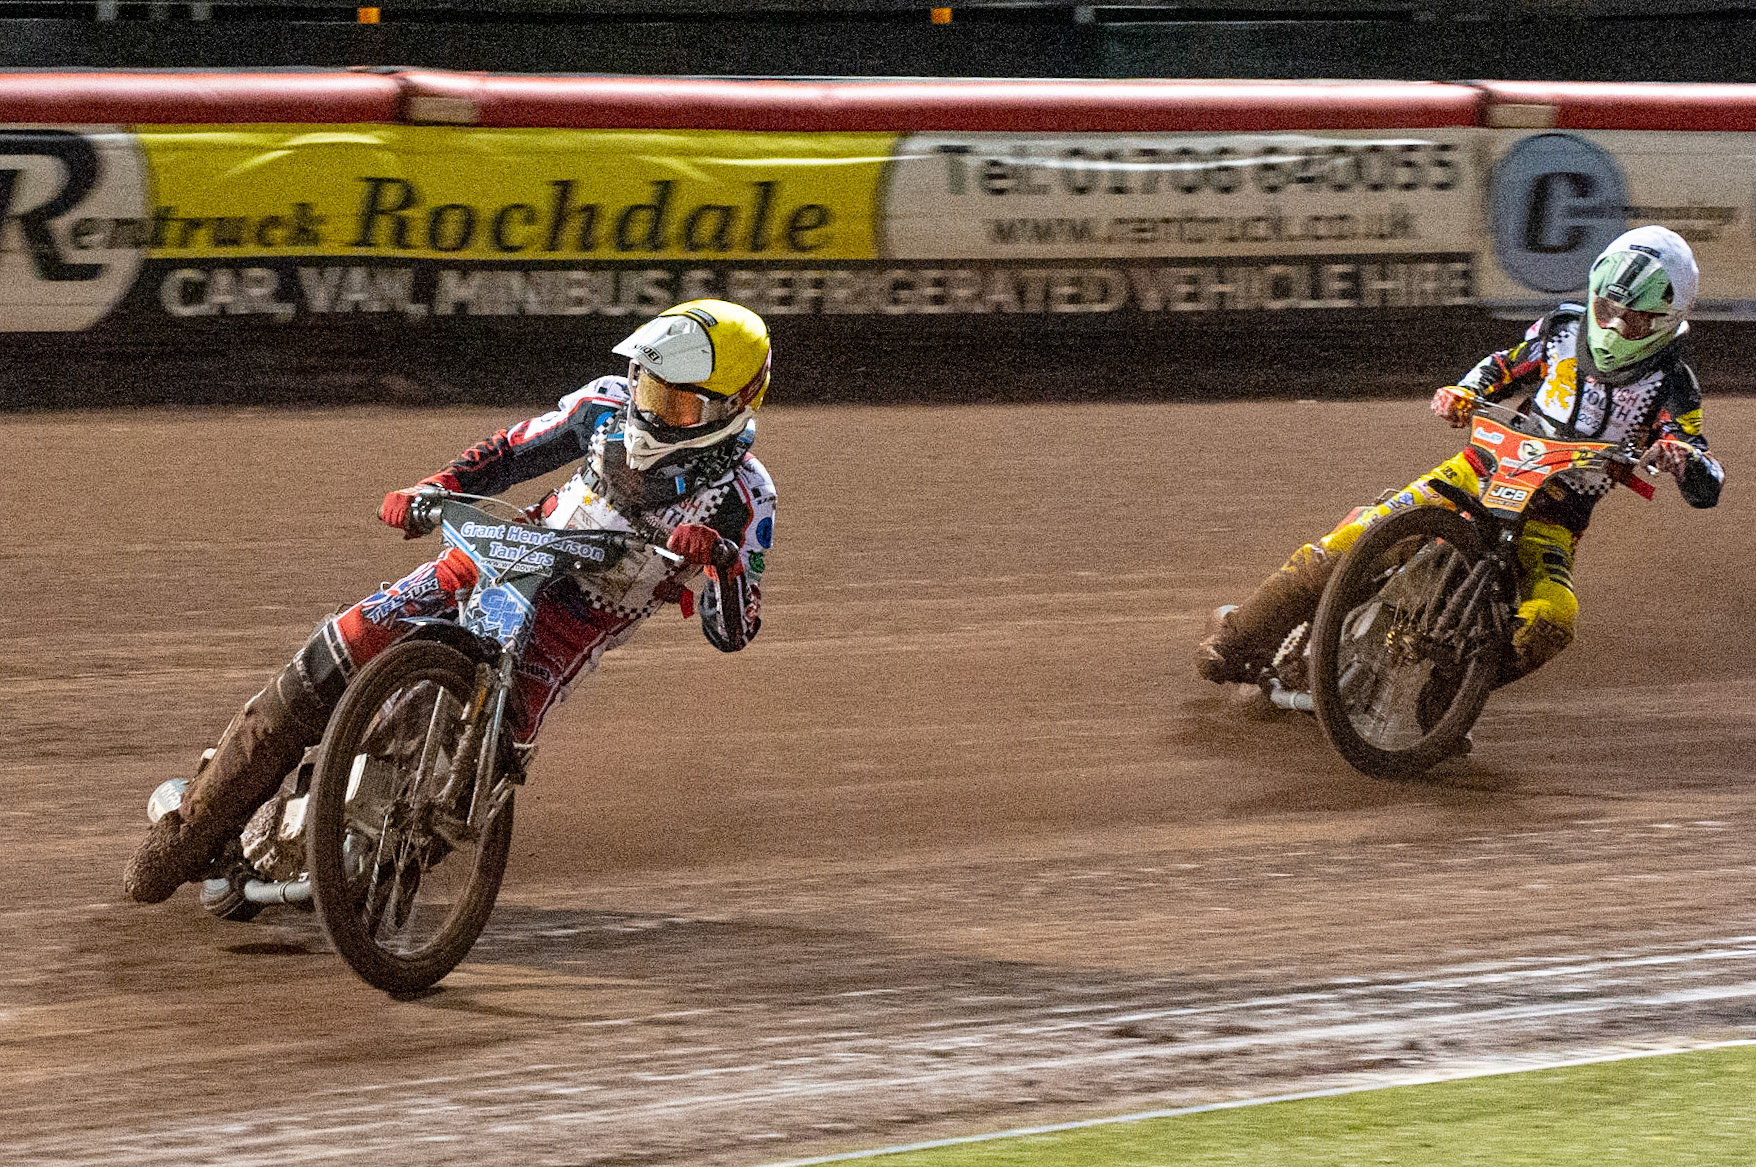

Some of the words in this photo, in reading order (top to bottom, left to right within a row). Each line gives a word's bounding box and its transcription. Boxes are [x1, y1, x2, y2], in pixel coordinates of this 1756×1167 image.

[352, 176, 836, 254] Rochdale
[435, 268, 673, 315] MINIBUS
[727, 269, 1128, 315] REFRIGERATED
[1131, 264, 1356, 312] VEHICLE
[1362, 262, 1473, 308] HIRE
[1490, 485, 1529, 502] JCB
[460, 521, 506, 538] Grant
[506, 525, 605, 562] Henderson
[489, 541, 555, 566] Tankers
